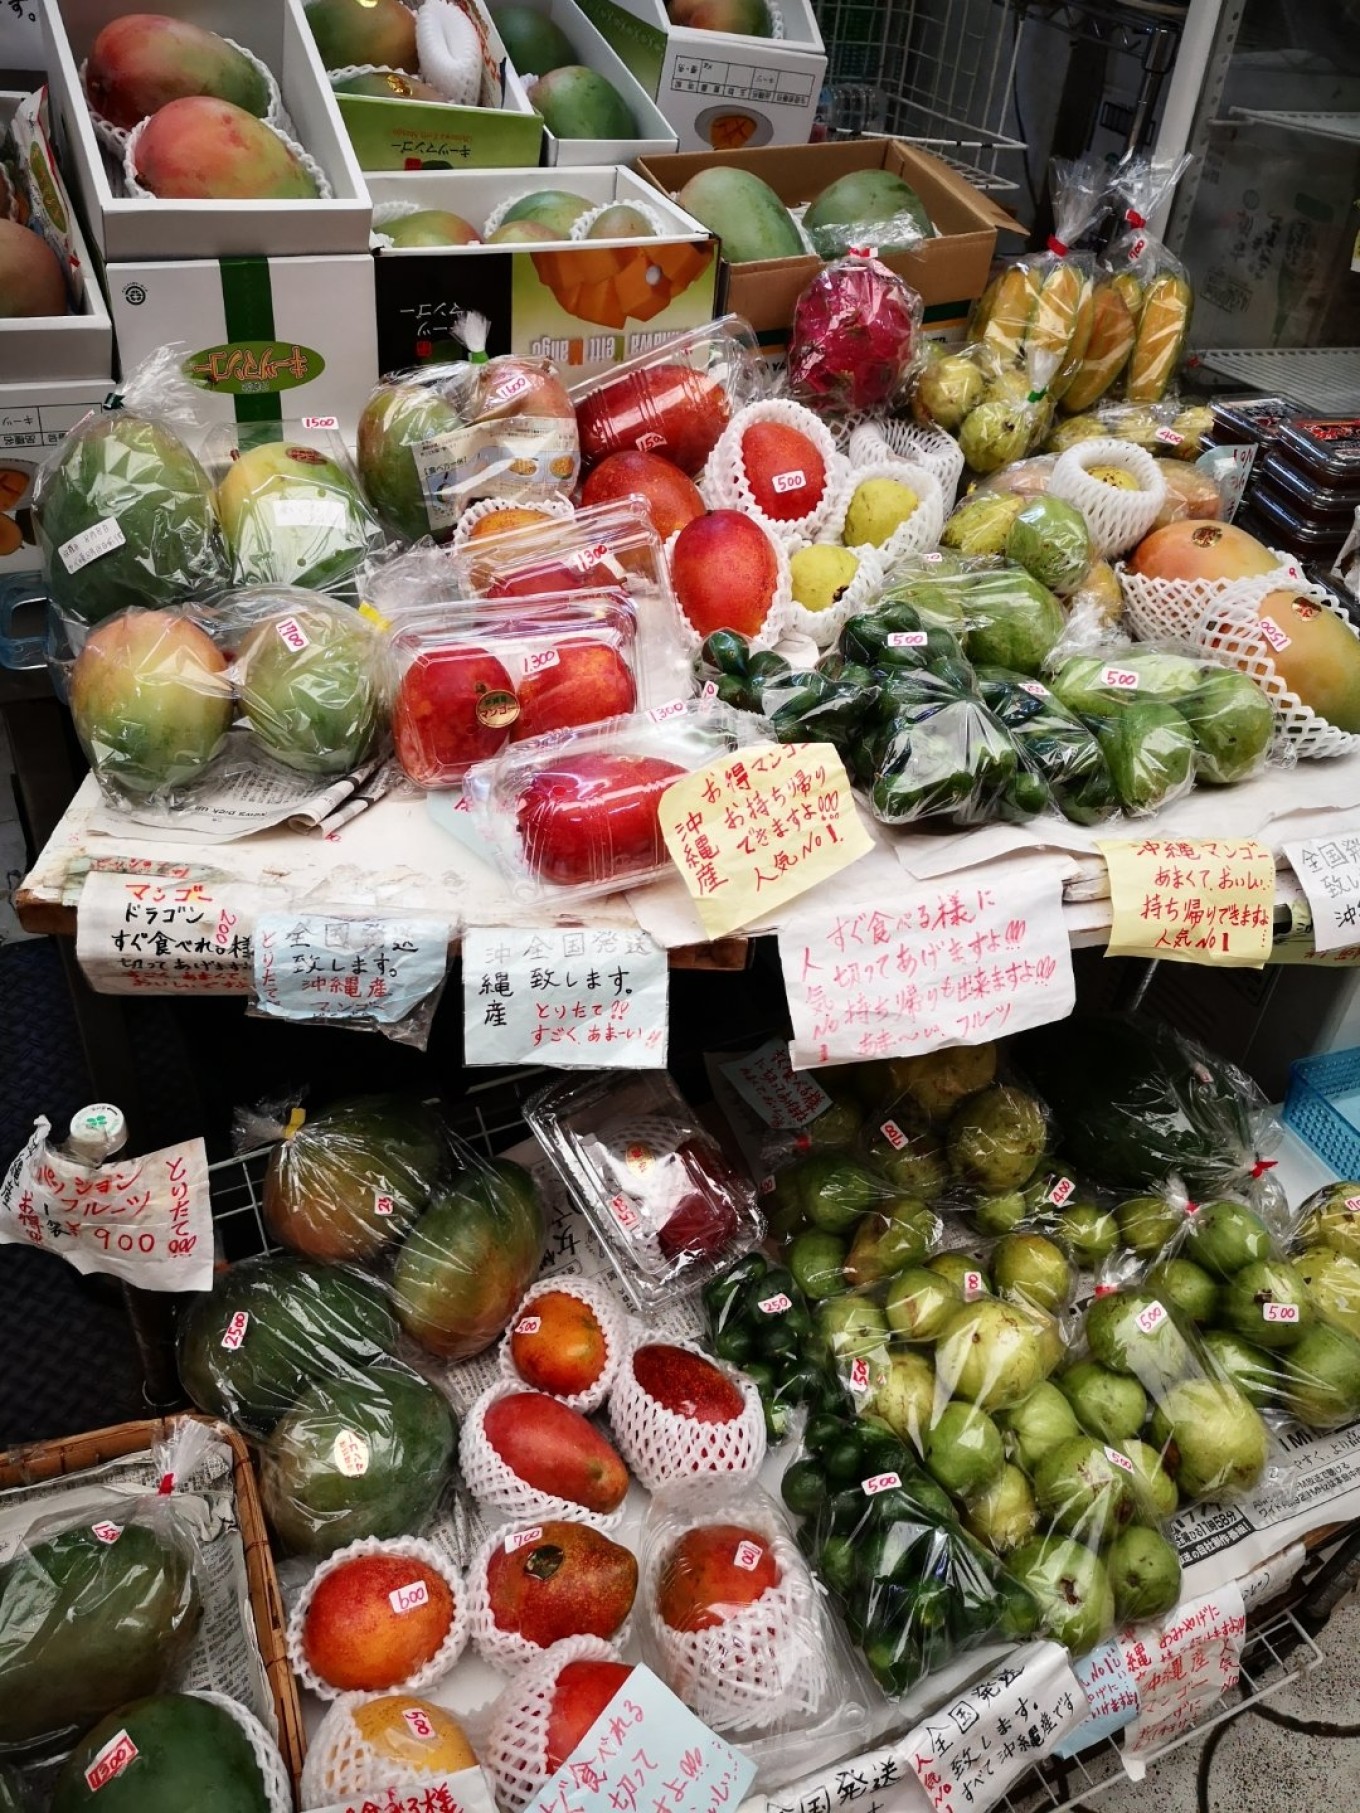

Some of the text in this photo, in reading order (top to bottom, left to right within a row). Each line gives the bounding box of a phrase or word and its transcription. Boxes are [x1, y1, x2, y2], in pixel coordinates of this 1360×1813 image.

[392, 141, 471, 158] キーツマンゴー
[777, 475, 802, 491] 500
[893, 634, 924, 645] 500
[1107, 671, 1137, 686] 500
[125, 884, 213, 902] マンゴー
[125, 902, 205, 925] ドラゴン
[522, 931, 653, 961] 全国発送
[302, 975, 390, 998] 沖縄産
[479, 942, 515, 1027] 沖縄産
[36, 1159, 145, 1196] パッション
[60, 1190, 151, 1217] フルーツ
[763, 1298, 788, 1312] 250
[1269, 1306, 1296, 1319] 500
[1139, 1306, 1163, 1331] 500
[868, 1477, 897, 1491] 500
[514, 1530, 540, 1547] 700
[397, 1587, 425, 1610] 600
